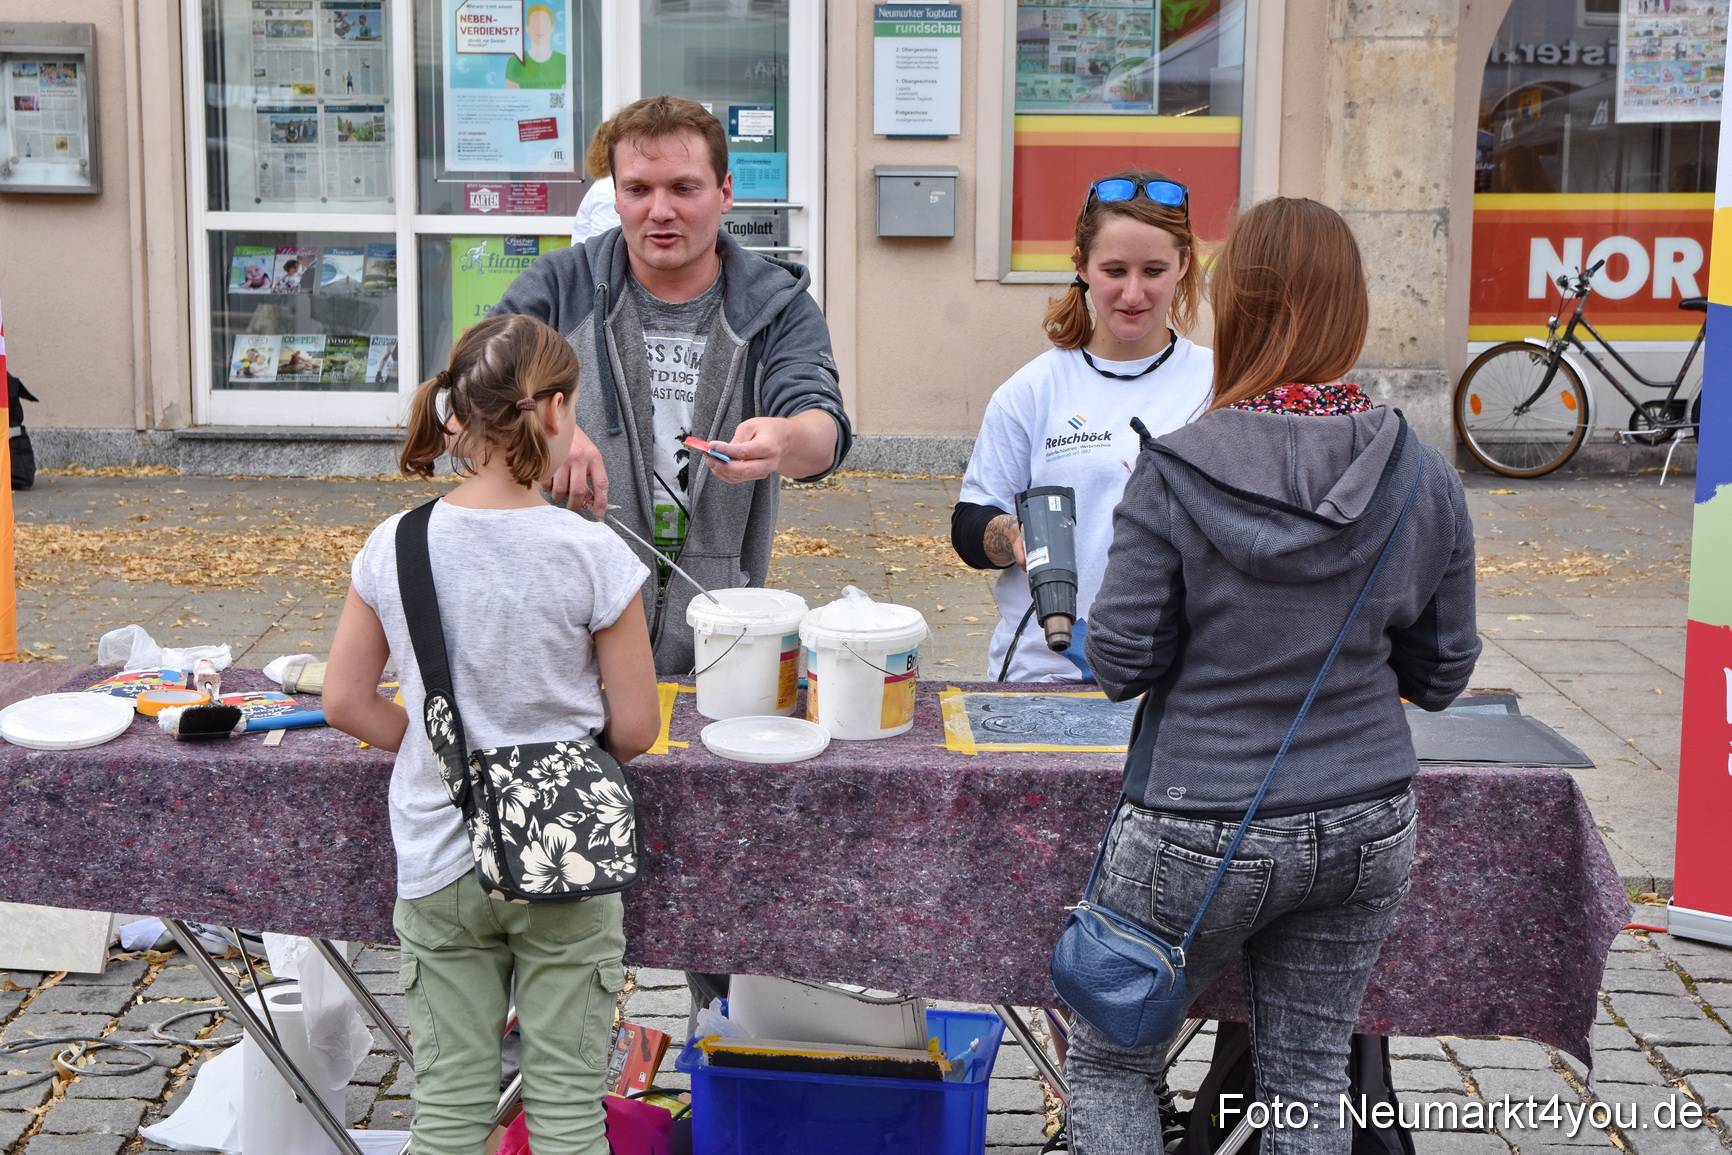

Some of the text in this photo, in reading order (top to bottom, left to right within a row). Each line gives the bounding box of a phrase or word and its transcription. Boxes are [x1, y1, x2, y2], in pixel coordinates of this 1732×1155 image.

[460, 15, 498, 23] NEBEN-
[878, 8, 957, 19] Neumarkter Tagblatt
[460, 27, 519, 35] VERDIENST?
[895, 22, 960, 33] rundschau
[470, 195, 499, 206] KARTEN
[724, 221, 773, 237] Tagblatt
[1528, 235, 1704, 300] NOR
[1045, 430, 1112, 450] Reischböck
